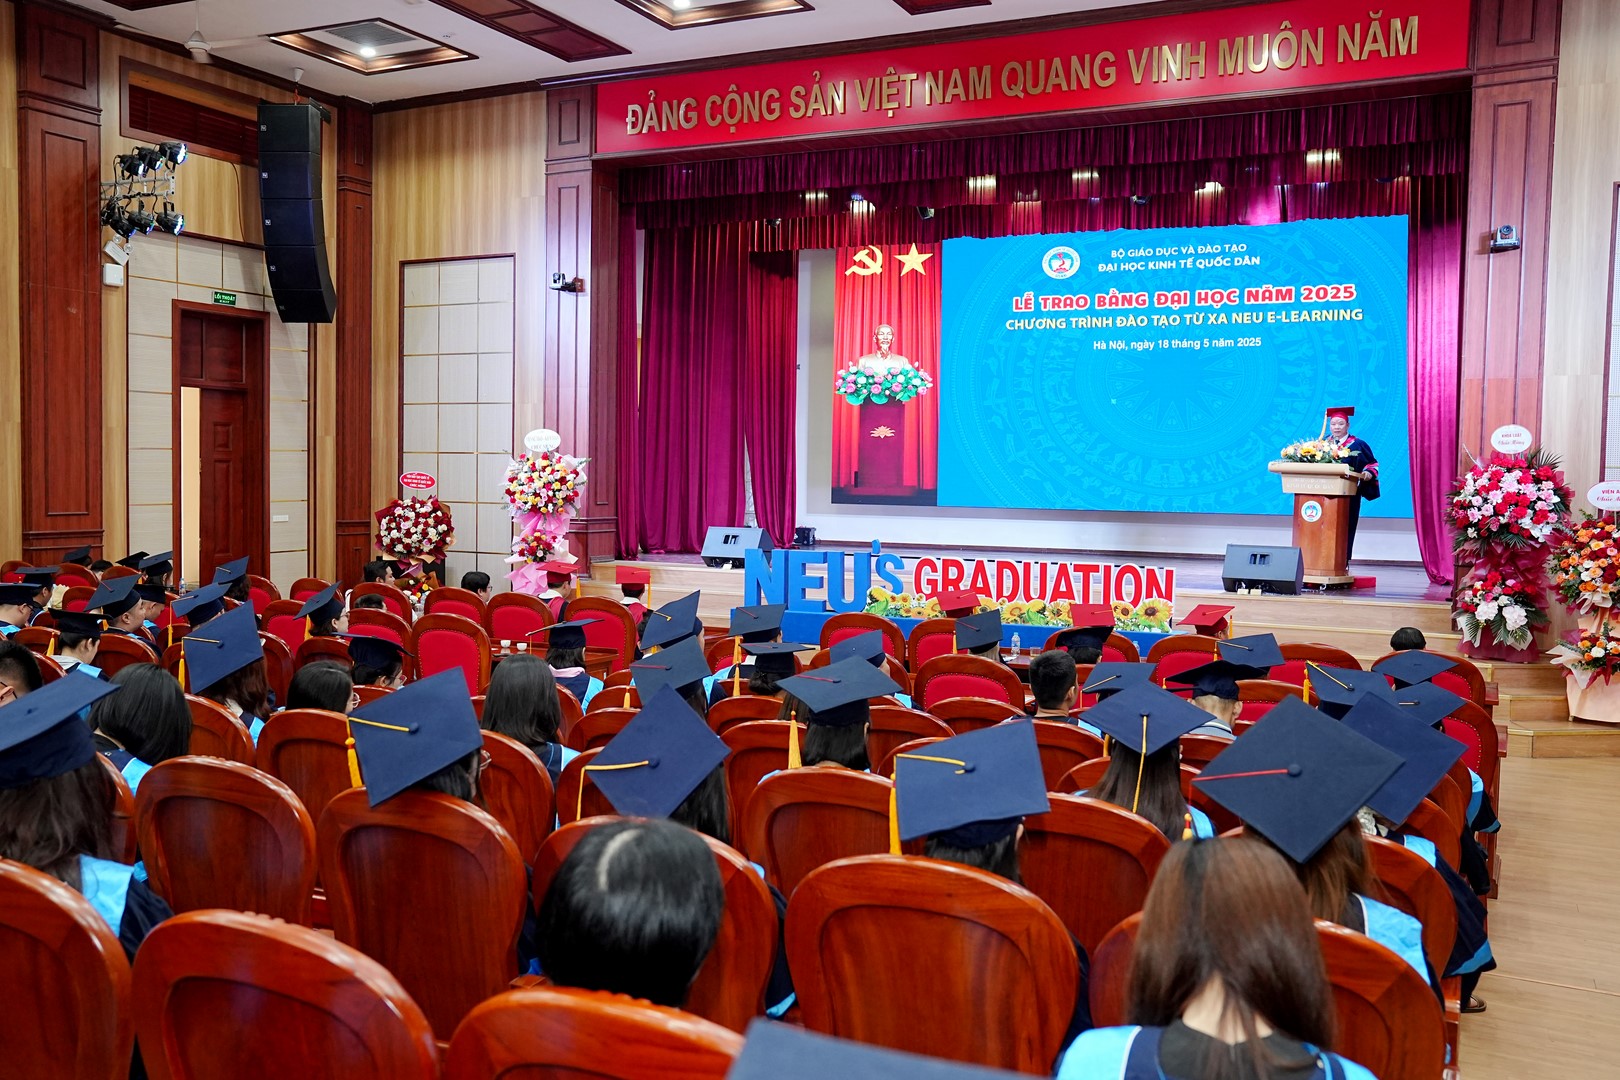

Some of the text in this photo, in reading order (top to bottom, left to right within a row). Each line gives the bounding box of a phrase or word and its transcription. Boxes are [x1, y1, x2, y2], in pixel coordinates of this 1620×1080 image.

[626, 10, 1419, 135] ĐẢNG CỘNG SẢN VIỆT NAM QUANG VINH MUÔN NĂM
[1111, 243, 1247, 259] BỘ GIÁO DỤC VÀ ĐÀO TẠO
[1098, 255, 1261, 273] ĐẠI HỌC KINH TẾ QUỐC DÂN
[1014, 285, 1356, 311] LỄ TRAO BẰNG ĐẠI HỌC NĂM 2025
[1005, 309, 1363, 331] CHƯƠNG TRÌNH ĐÀO TẠO TỪ XA NEU E-LEARNING
[1093, 337, 1262, 351] Hà Nội, ngày 18 tháng 5 năm 2025
[914, 557, 1175, 608] GRADUATION
